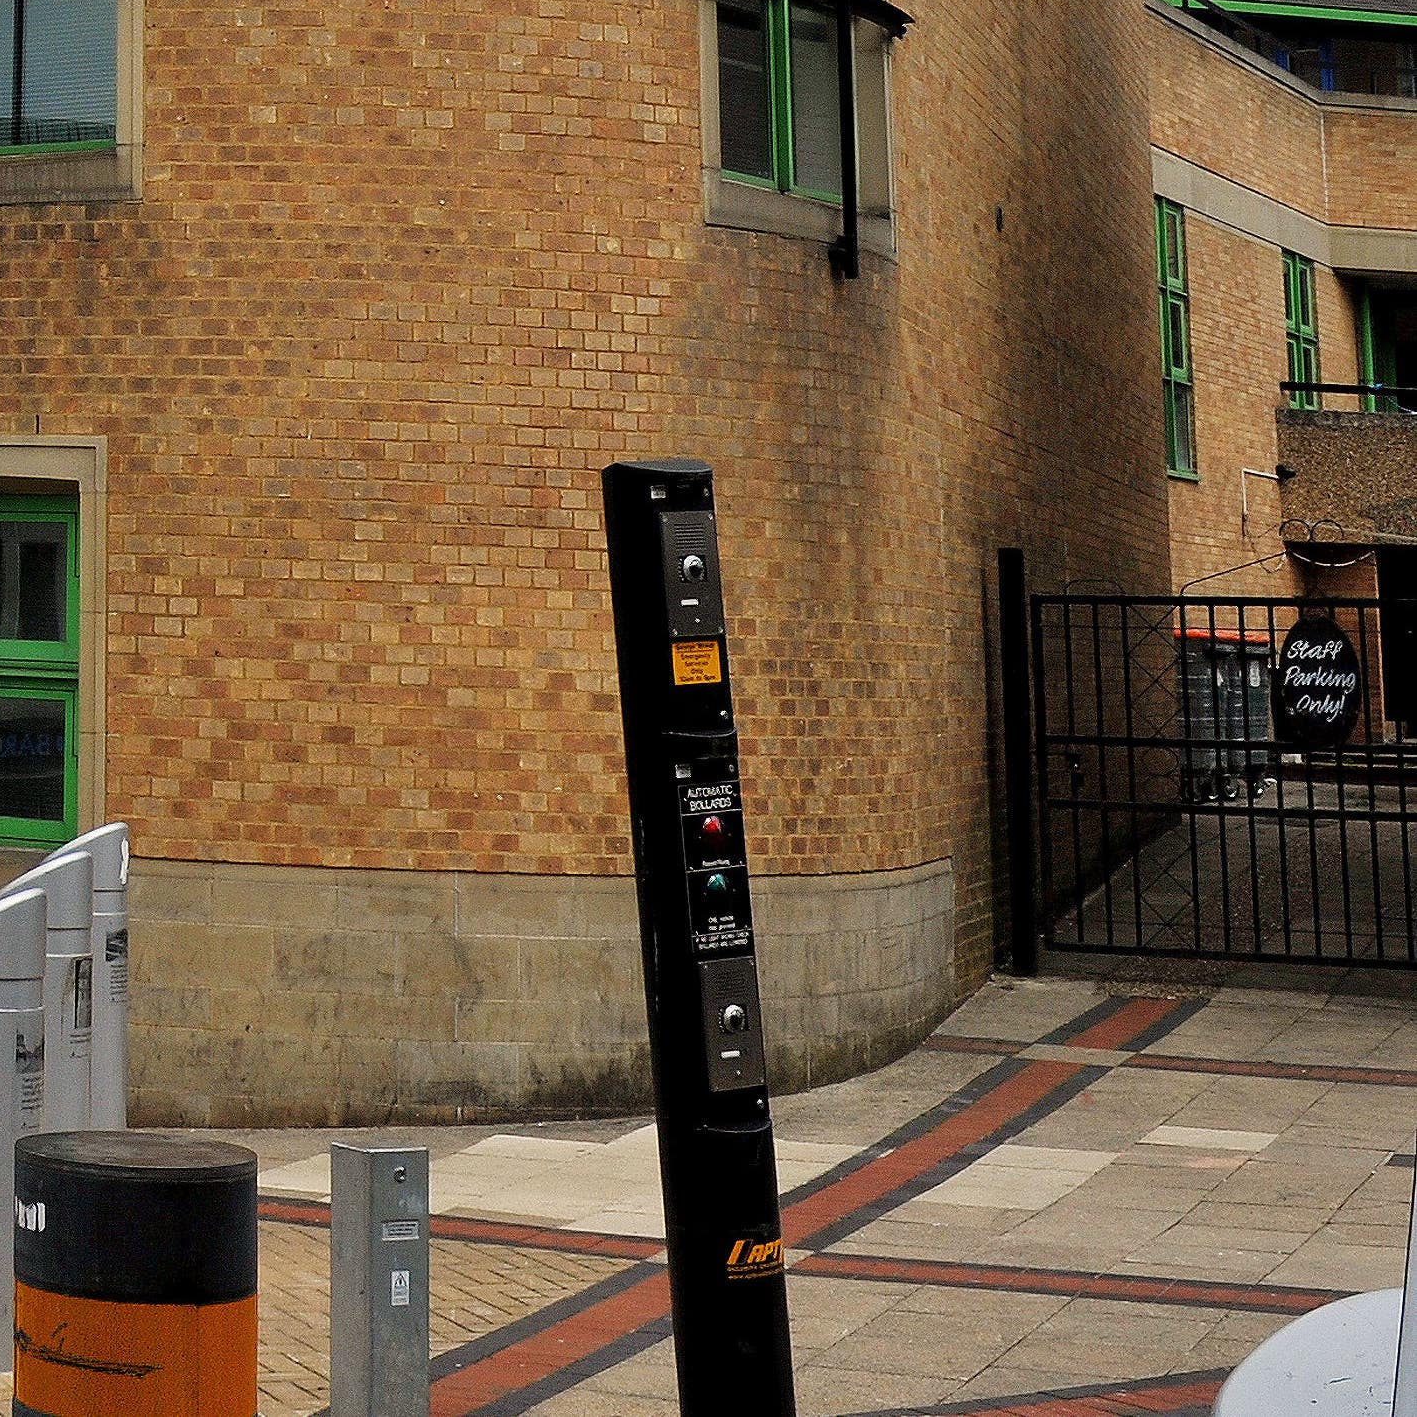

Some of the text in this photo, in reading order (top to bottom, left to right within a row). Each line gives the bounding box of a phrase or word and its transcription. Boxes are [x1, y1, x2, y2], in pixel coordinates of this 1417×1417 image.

[1286, 639, 1344, 660] Staff
[1283, 665, 1357, 695] Parking
[1296, 694, 1346, 723] Only!
[686, 784, 734, 799] AUTOMATIC
[689, 796, 733, 812] BOLLARDS
